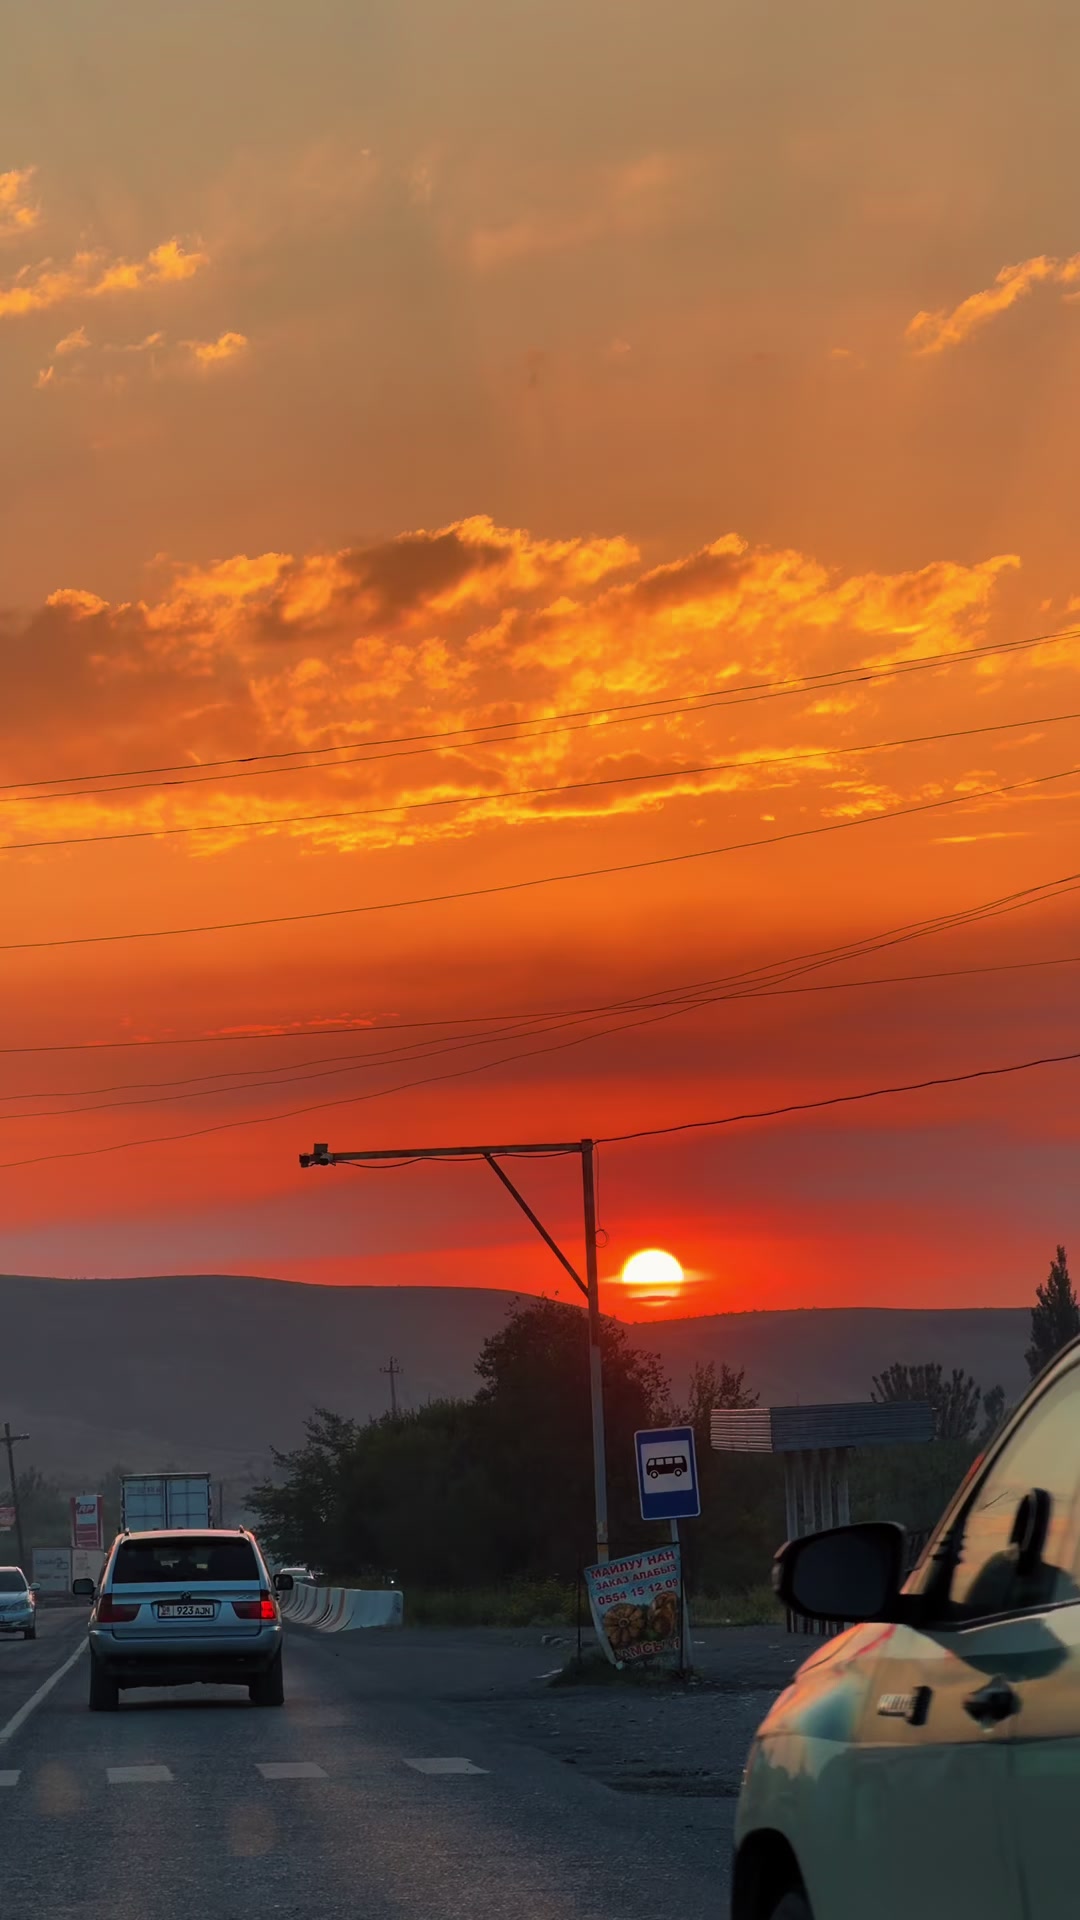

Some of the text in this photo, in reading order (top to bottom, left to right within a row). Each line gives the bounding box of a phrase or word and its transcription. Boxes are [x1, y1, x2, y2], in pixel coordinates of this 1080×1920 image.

[647, 1551, 674, 1565] НАН
[596, 1565, 677, 1590] ЗАКАЗ АЛАБЫЗ
[598, 1578, 678, 1605] 0554 15 12 09
